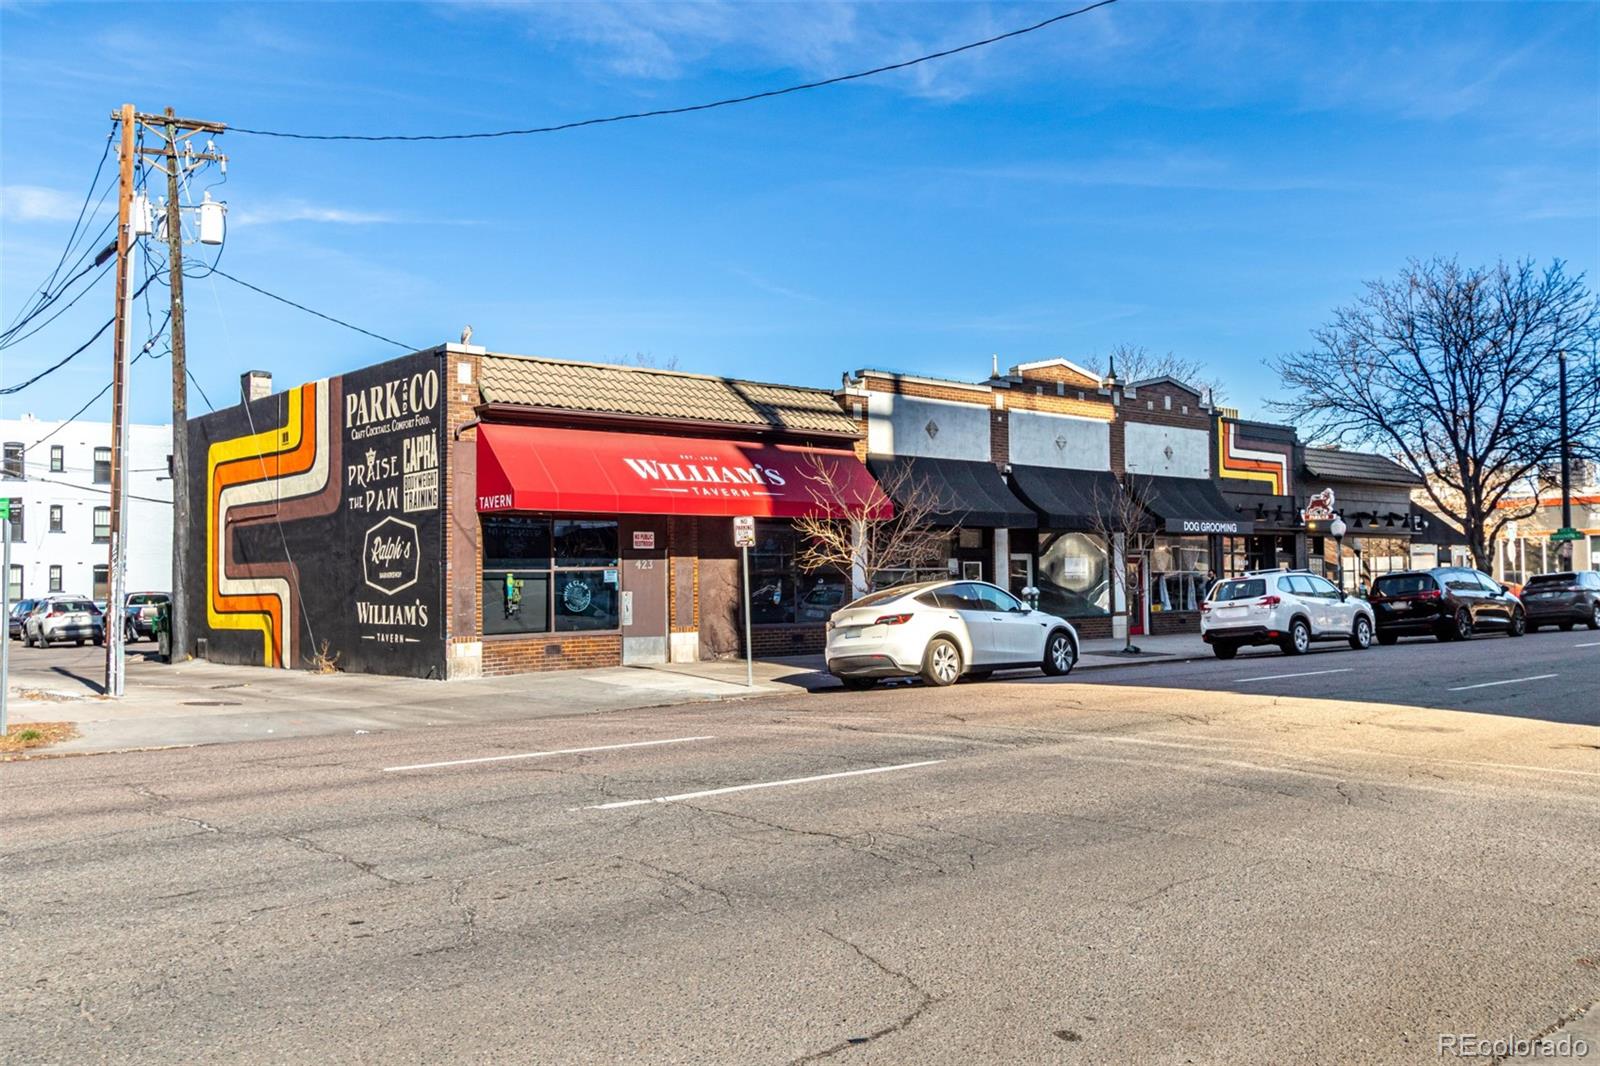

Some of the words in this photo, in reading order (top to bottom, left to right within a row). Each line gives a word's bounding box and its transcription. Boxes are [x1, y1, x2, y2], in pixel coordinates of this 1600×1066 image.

[346, 380, 400, 428] PARK
[409, 369, 439, 413] CO
[347, 456, 399, 488] PRAISE
[623, 457, 786, 486] WILLIAM'S
[348, 496, 364, 510] THE
[365, 486, 399, 513] PAW
[404, 487, 437, 511] TRAINING
[479, 494, 512, 509] TAVERN
[692, 487, 750, 497] TAVERN
[1183, 521, 1200, 532] DOG
[1200, 522, 1238, 533] GROOMING
[371, 536, 411, 568] Ralph's
[635, 560, 653, 570] 423
[356, 598, 429, 627] WILLIAM'S
[377, 633, 404, 643] TAVERN
